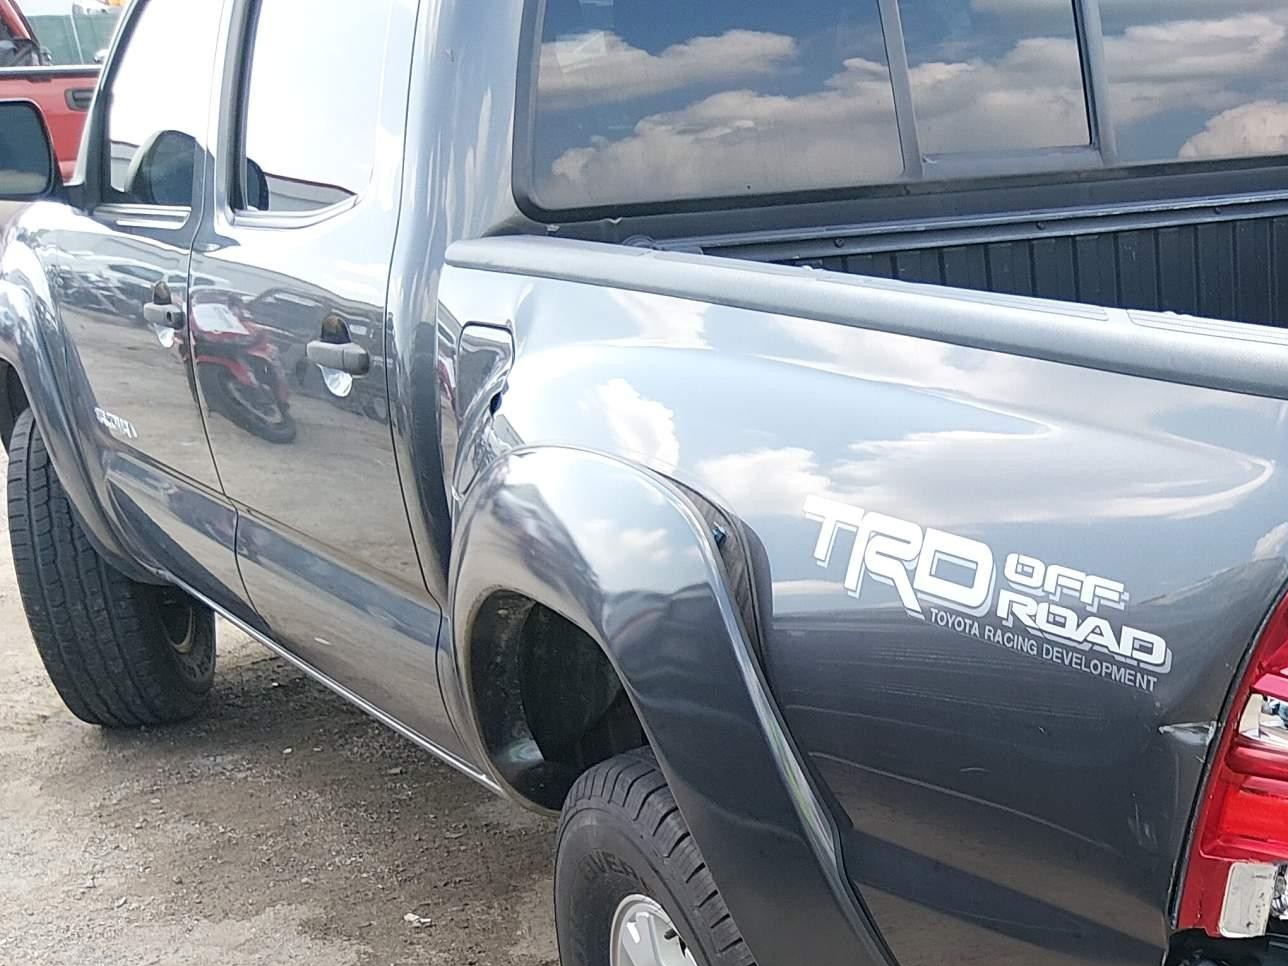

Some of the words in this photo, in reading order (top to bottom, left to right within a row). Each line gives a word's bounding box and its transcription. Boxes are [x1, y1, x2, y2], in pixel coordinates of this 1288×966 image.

[803, 494, 996, 620] TRD
[1003, 552, 1129, 611] OFF
[929, 606, 981, 639] TOYOTA
[984, 624, 1038, 657] RACING
[1042, 643, 1160, 693] DEVELOPMENT
[997, 589, 1172, 674] ROAD
